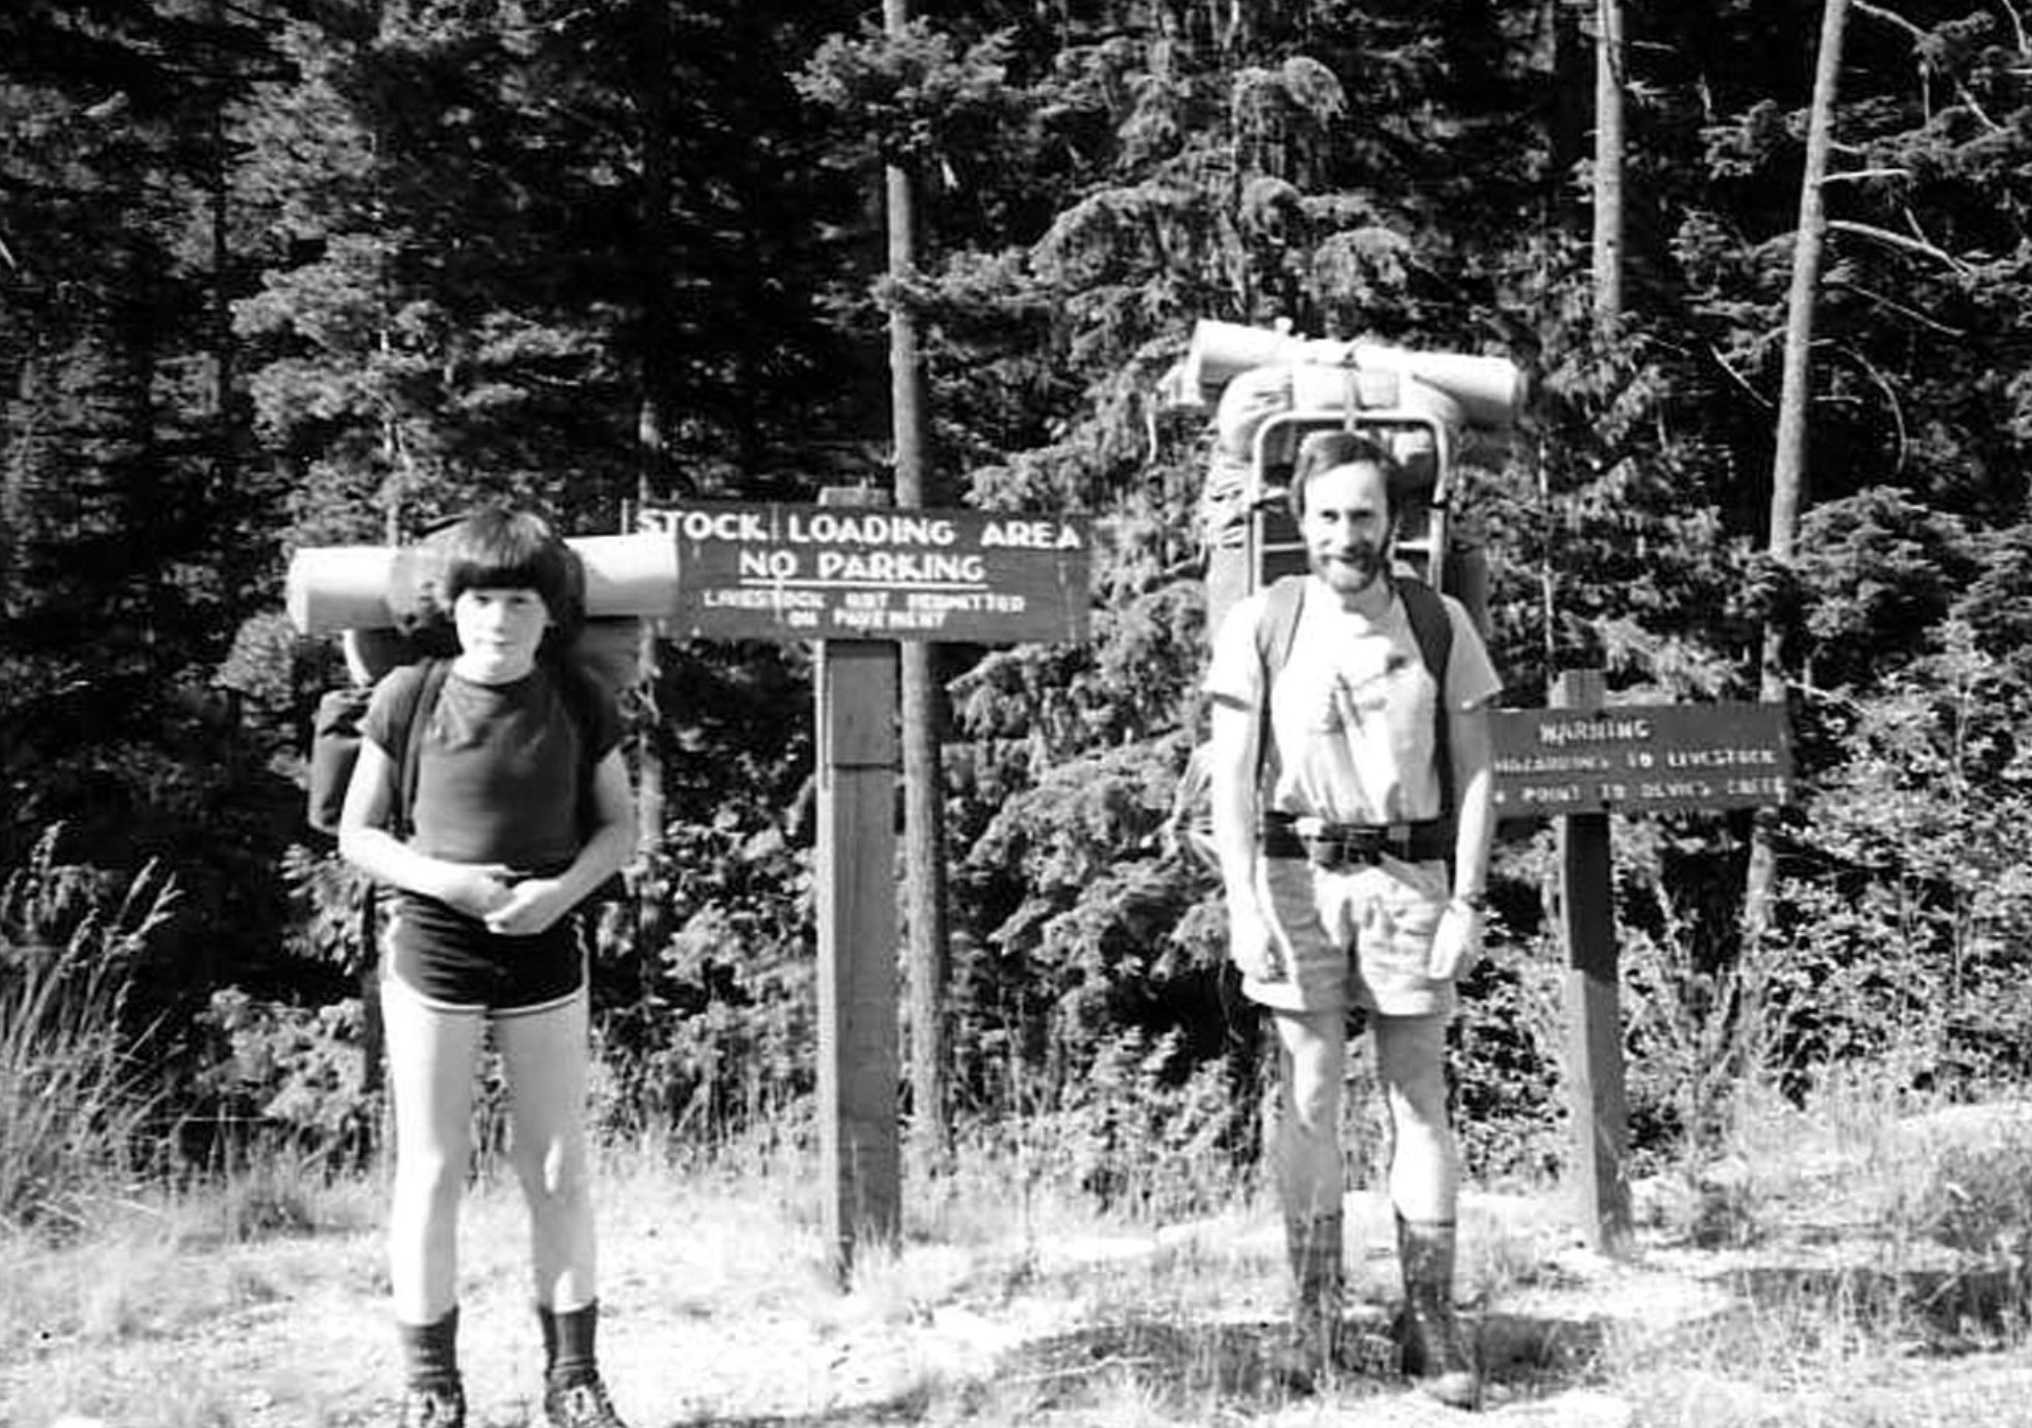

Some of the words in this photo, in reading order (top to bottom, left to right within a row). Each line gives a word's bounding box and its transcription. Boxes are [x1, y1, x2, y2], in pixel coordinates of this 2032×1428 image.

[636, 508, 768, 541] STOCK
[788, 513, 957, 546] LOADING
[979, 521, 1082, 550] AREA
[739, 549, 797, 577] NO
[817, 551, 986, 582] PARKING
[1540, 719, 1651, 746] WARNING
